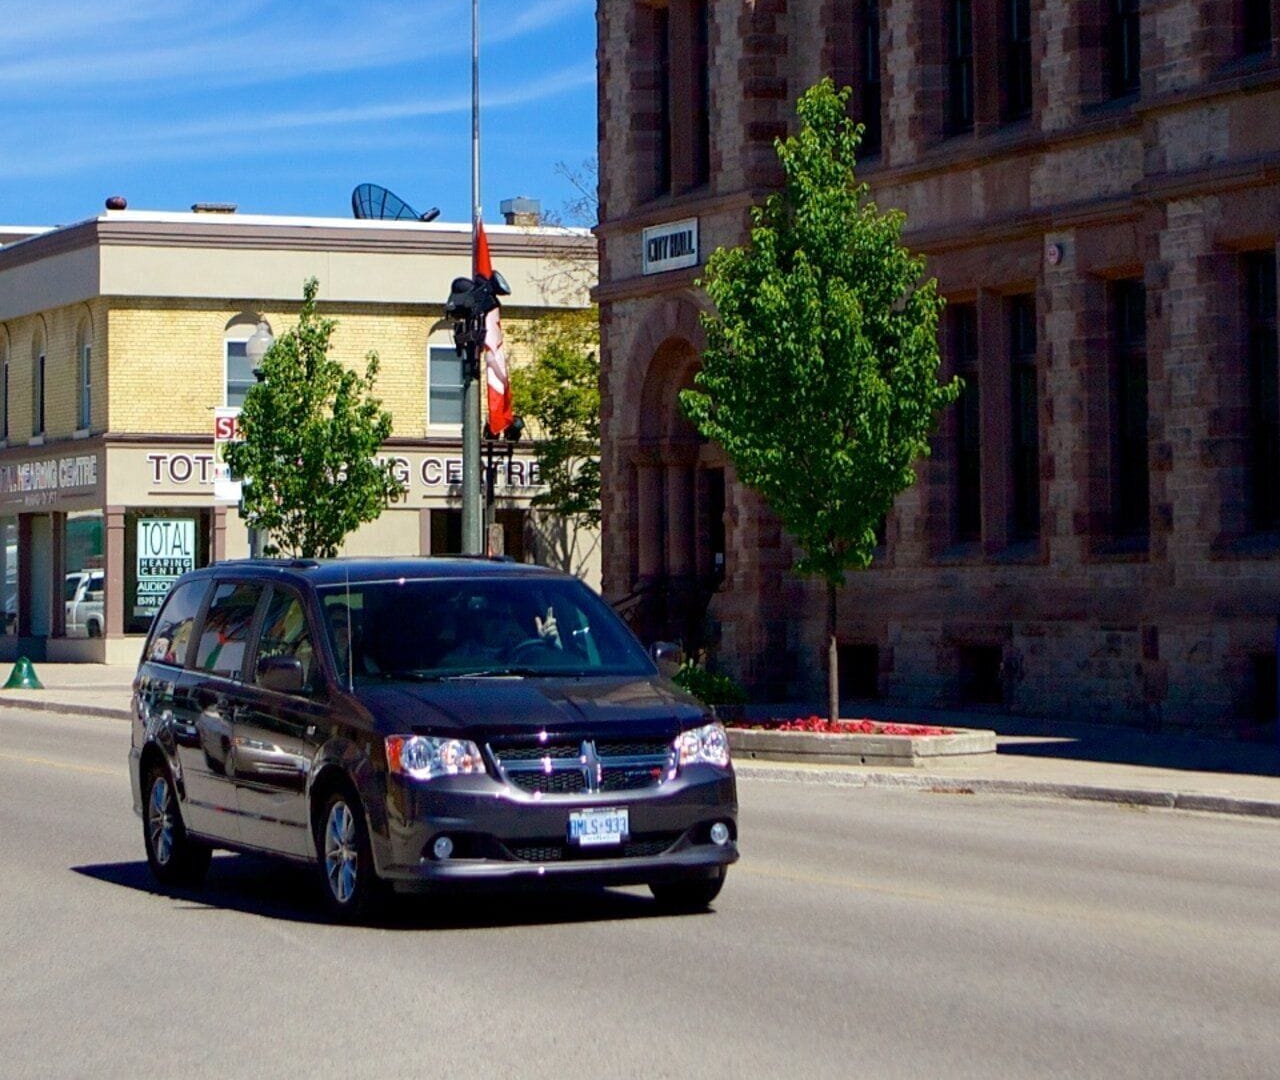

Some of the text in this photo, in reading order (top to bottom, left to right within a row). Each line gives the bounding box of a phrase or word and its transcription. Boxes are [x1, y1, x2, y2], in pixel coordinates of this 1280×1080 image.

[648, 230, 696, 262] CITY HALL
[17, 460, 58, 492] HEARING
[59, 455, 97, 488] CENTRE
[148, 453, 214, 484] TOT
[142, 522, 191, 556] TOTAL
[140, 559, 191, 568] HEARING
